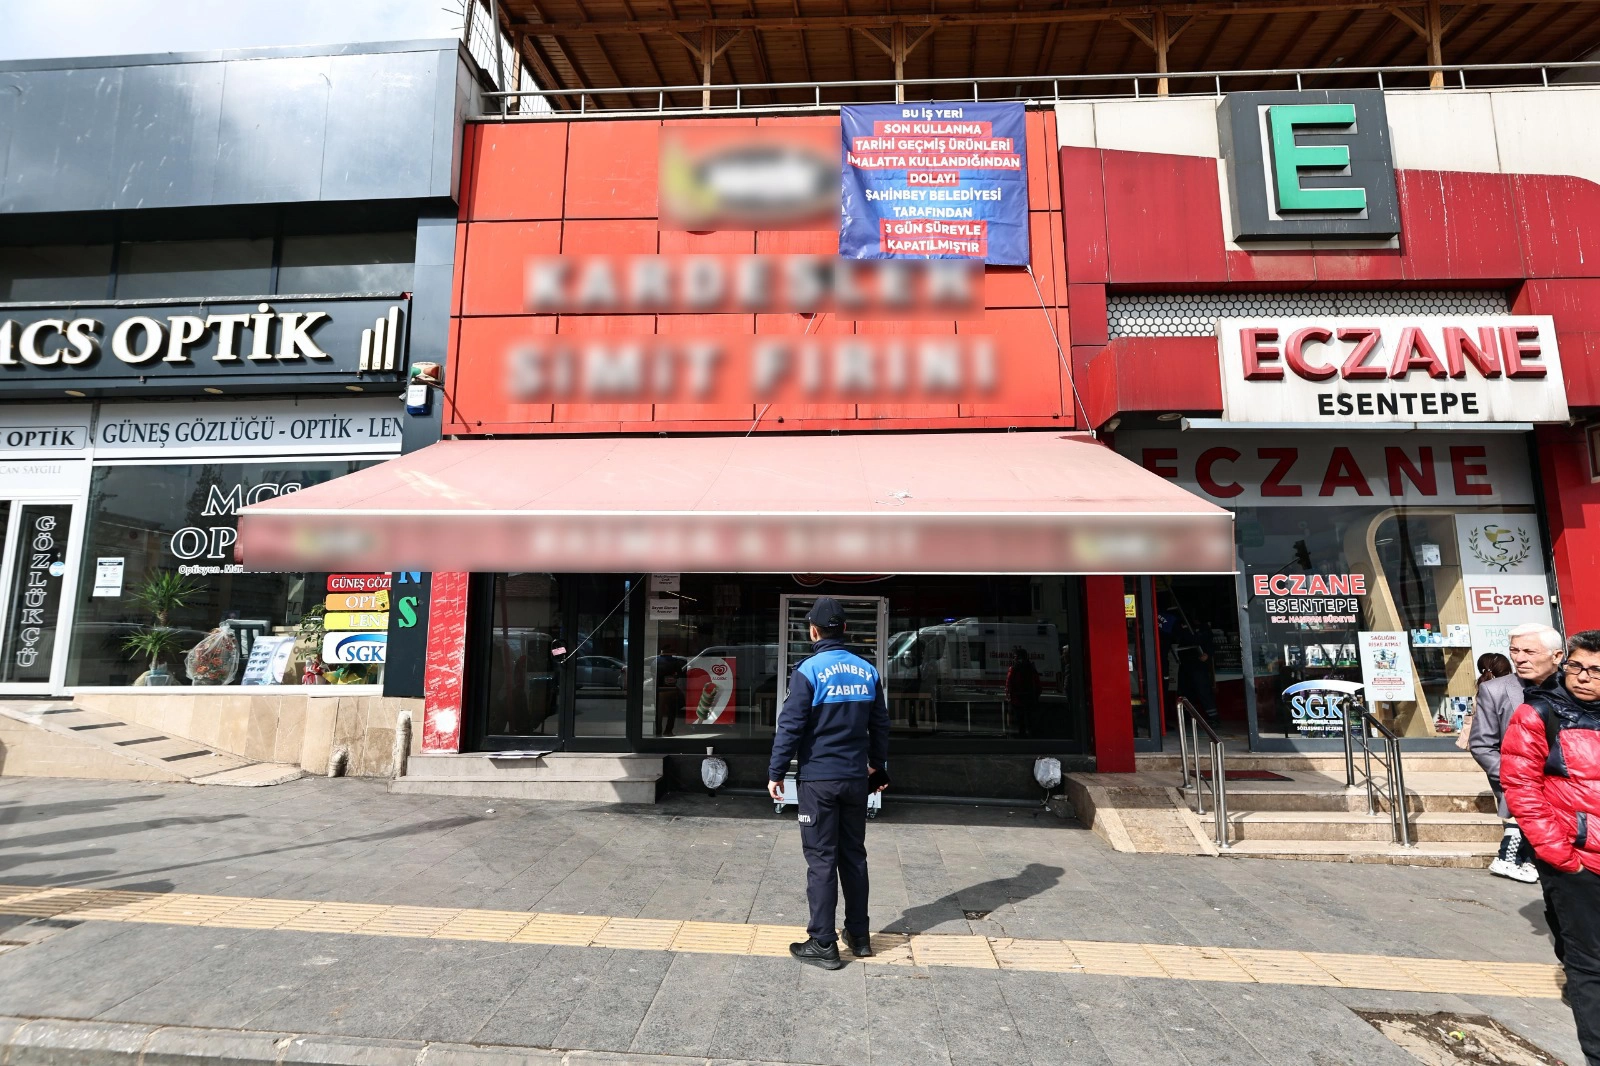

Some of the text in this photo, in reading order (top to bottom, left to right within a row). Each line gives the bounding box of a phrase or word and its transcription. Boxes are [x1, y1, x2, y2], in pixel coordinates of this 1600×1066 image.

[902, 107, 963, 121] BU İŞ YERİ
[884, 124, 982, 134] SON KULLANMA
[856, 138, 1011, 153] TARİHİ GEÇMİŞ ÜRÜNLERİ
[847, 152, 1020, 168] İMALATTA KULLANDIĞINDAN
[1267, 104, 1367, 213] E
[910, 173, 956, 184] DOLAYI
[865, 188, 1002, 202] ŞAHİNBEY BELEDİYESİ
[893, 207, 972, 218] TARAFINDAN
[885, 221, 981, 236] 3 GÜN SÜREYLE
[887, 239, 980, 253] KAPATILMIŞTIR
[112, 303, 328, 364] OPTİK
[1239, 326, 1548, 381] ECZANE
[1318, 392, 1480, 416] ESENTEPE
[7, 427, 76, 447] OPTİK
[102, 420, 171, 448] GÜNEŞ
[175, 415, 275, 442] GÖZLÜĞÜ
[290, 413, 353, 439] OPTİK
[369, 417, 404, 438] LEN
[170, 526, 238, 560] OP
[331, 577, 365, 590] GÜNEŞ
[1253, 574, 1367, 596] ECZANE
[17, 515, 57, 668] GÖZLÜKÇÜ
[345, 596, 377, 609] OPT
[1265, 598, 1360, 613] ESENTEPE
[1474, 589, 1545, 611] Eczane
[1485, 628, 1510, 638] PHAR
[1489, 640, 1511, 648] APO
[345, 645, 385, 662] SGK
[817, 661, 873, 684] ŞAHİNBEY
[827, 684, 869, 696] ZABITA
[1291, 695, 1344, 719] SGK
